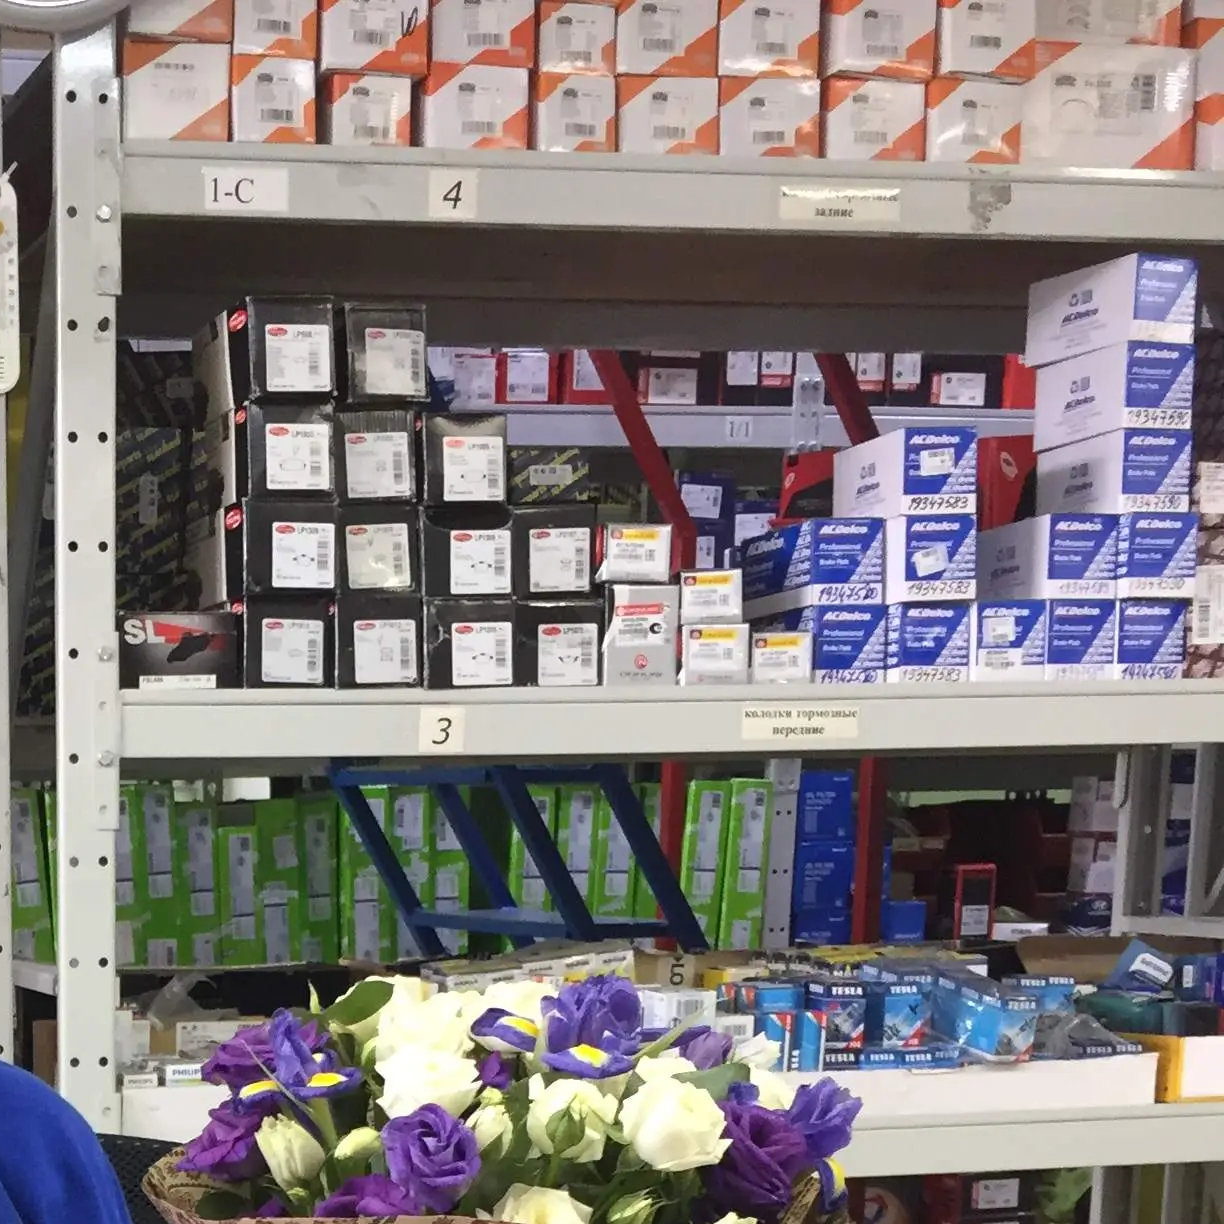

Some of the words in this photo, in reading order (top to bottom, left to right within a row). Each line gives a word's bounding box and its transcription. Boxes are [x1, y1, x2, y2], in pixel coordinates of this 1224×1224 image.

[210, 178, 255, 204] 1-C
[442, 180, 463, 209] 4
[909, 434, 960, 445] ACDelco
[1129, 435, 1177, 446] ACDelco
[908, 496, 969, 511] 19347583
[911, 522, 961, 532] ACDelco
[1054, 521, 1103, 531] ACDelco
[1135, 519, 1183, 529] ACDelco
[819, 524, 869, 535] ACDelco
[823, 611, 872, 621] ACDelco
[907, 608, 955, 618] ACDelco
[982, 607, 1030, 617] ACDelco
[1054, 606, 1101, 616] ACDelco
[1125, 606, 1171, 616] ACDelco
[431, 717, 453, 745] 3
[831, 986, 863, 996] TESLA
[826, 1053, 855, 1063] TESLA
